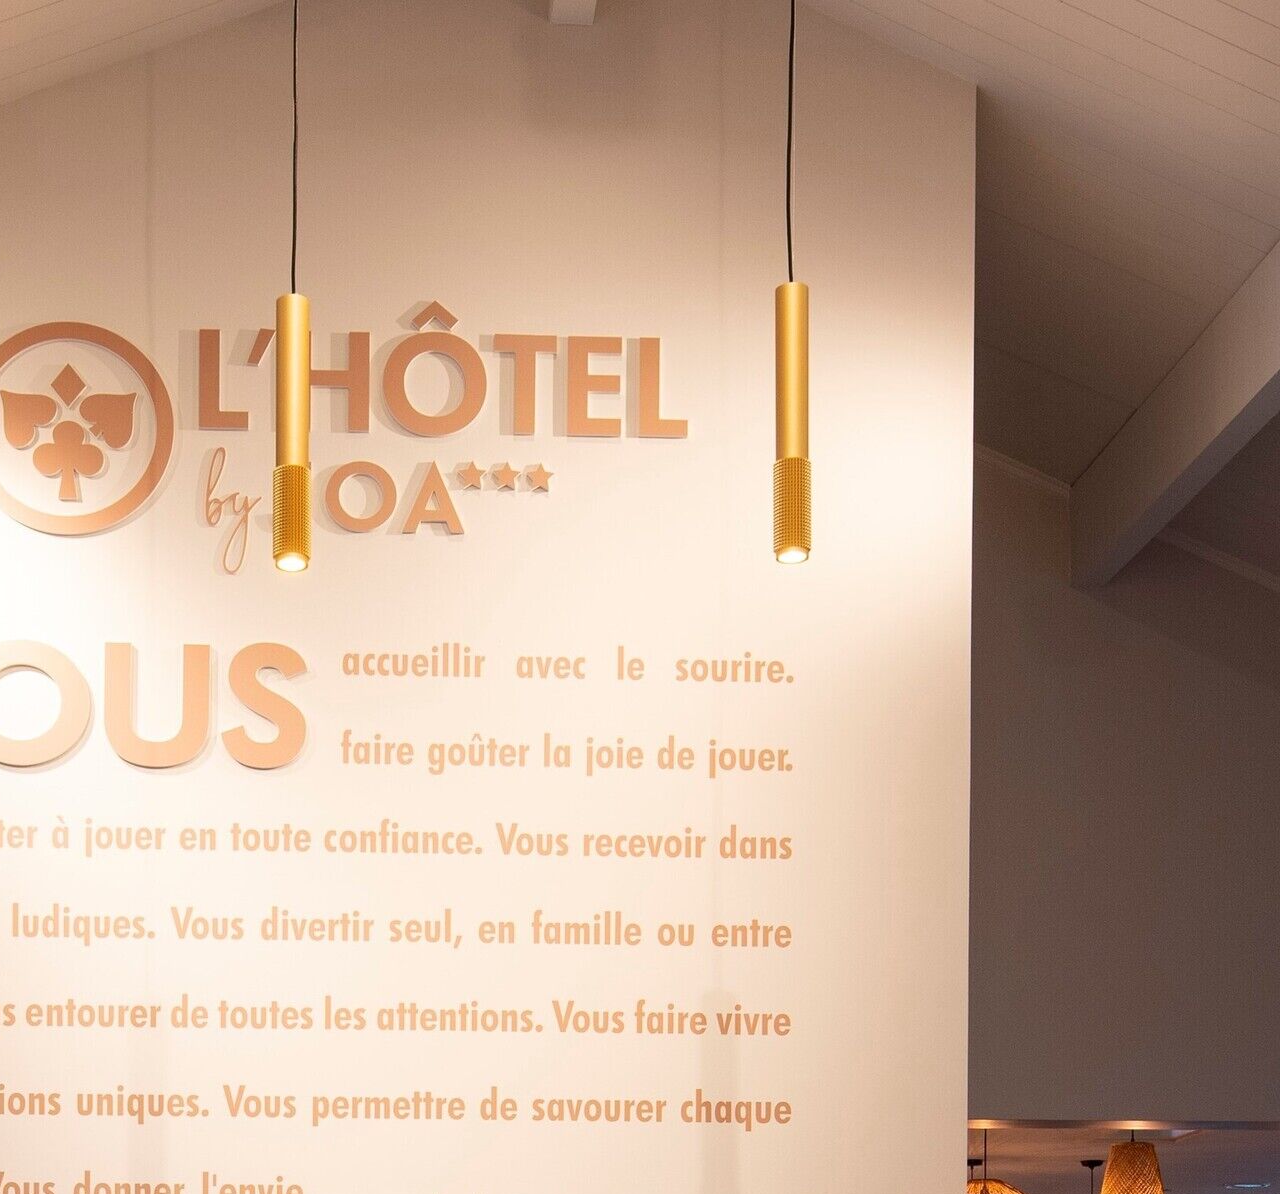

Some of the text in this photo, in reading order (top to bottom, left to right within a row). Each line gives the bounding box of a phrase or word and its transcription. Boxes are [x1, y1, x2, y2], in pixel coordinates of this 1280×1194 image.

[205, 446, 262, 575] by
[341, 641, 795, 684] accueillir avec le sourire.
[341, 729, 794, 780] faire goûter la joie de jouer.
[50, 812, 70, 850] à
[83, 814, 167, 859] jouer
[178, 827, 217, 851] en
[230, 823, 312, 853] toute
[323, 818, 483, 855] confiance.
[496, 822, 569, 857] Vous
[582, 826, 706, 859] recevoir
[718, 824, 794, 860] dans
[11, 903, 156, 946] ludiques.
[170, 905, 245, 941] Vous
[260, 905, 374, 942] divertir
[388, 908, 462, 948] seul,
[477, 920, 517, 944] en
[531, 909, 642, 946] famille
[657, 922, 696, 947] ou
[711, 918, 793, 949] entre
[24, 998, 161, 1029] entourer
[170, 993, 209, 1029] de
[217, 1000, 314, 1030] toutes
[323, 995, 367, 1031] les
[376, 1000, 544, 1033] attentions.
[551, 999, 626, 1035] Vous
[634, 997, 709, 1036] faire
[715, 1002, 792, 1037] vivre
[75, 1085, 210, 1126] uniques.
[223, 1083, 297, 1119] Vous
[311, 1090, 467, 1127] permettre
[478, 1086, 518, 1122] de
[531, 1097, 667, 1123] savourer
[680, 1088, 793, 1133] chaque
